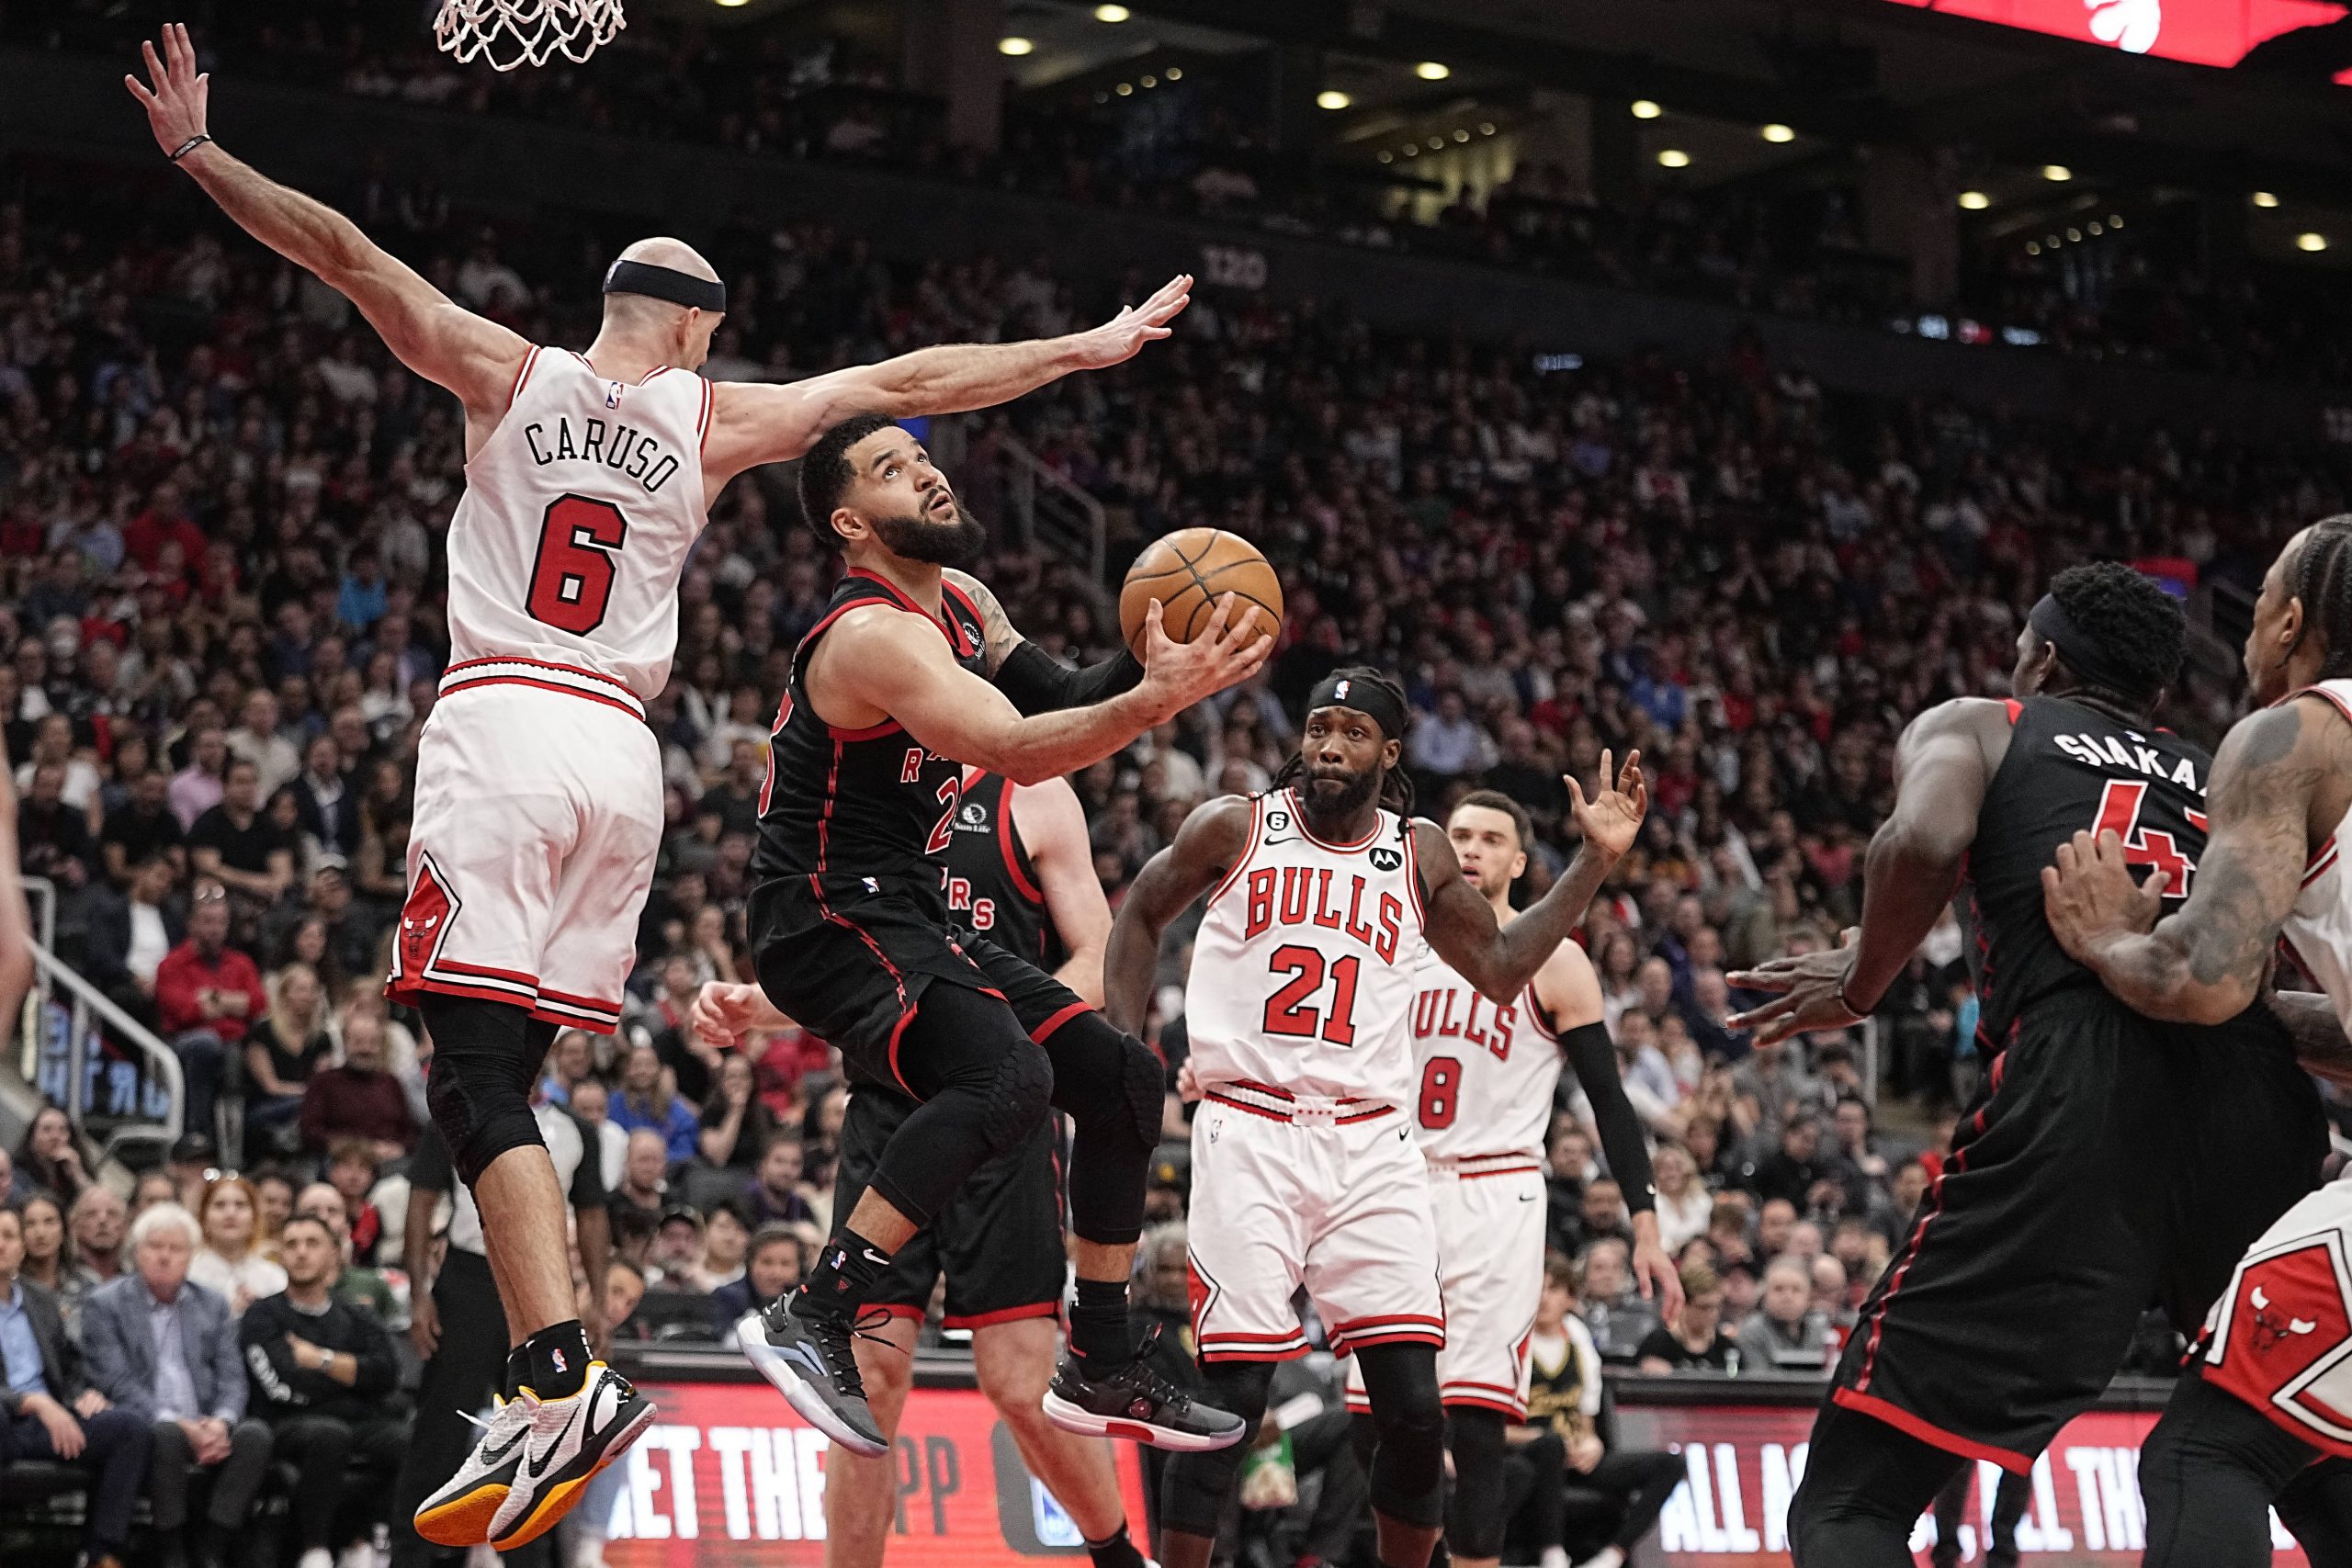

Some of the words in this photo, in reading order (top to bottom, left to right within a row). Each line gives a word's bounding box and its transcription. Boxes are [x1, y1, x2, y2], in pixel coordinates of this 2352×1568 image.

[524, 417, 679, 492] CARUSO
[525, 492, 628, 637] 6
[2053, 733, 2208, 797] SIAKA
[1270, 813, 1286, 829] 6
[2090, 778, 2210, 898] 4
[1245, 866, 1403, 966] BULLS
[1262, 943, 1361, 1047] 21
[1415, 988, 1519, 1062] ULLS
[1419, 1056, 1463, 1130] 8
[607, 1426, 701, 1540] ET
[708, 1427, 829, 1540] THE
[1659, 1442, 1760, 1552] ALL
